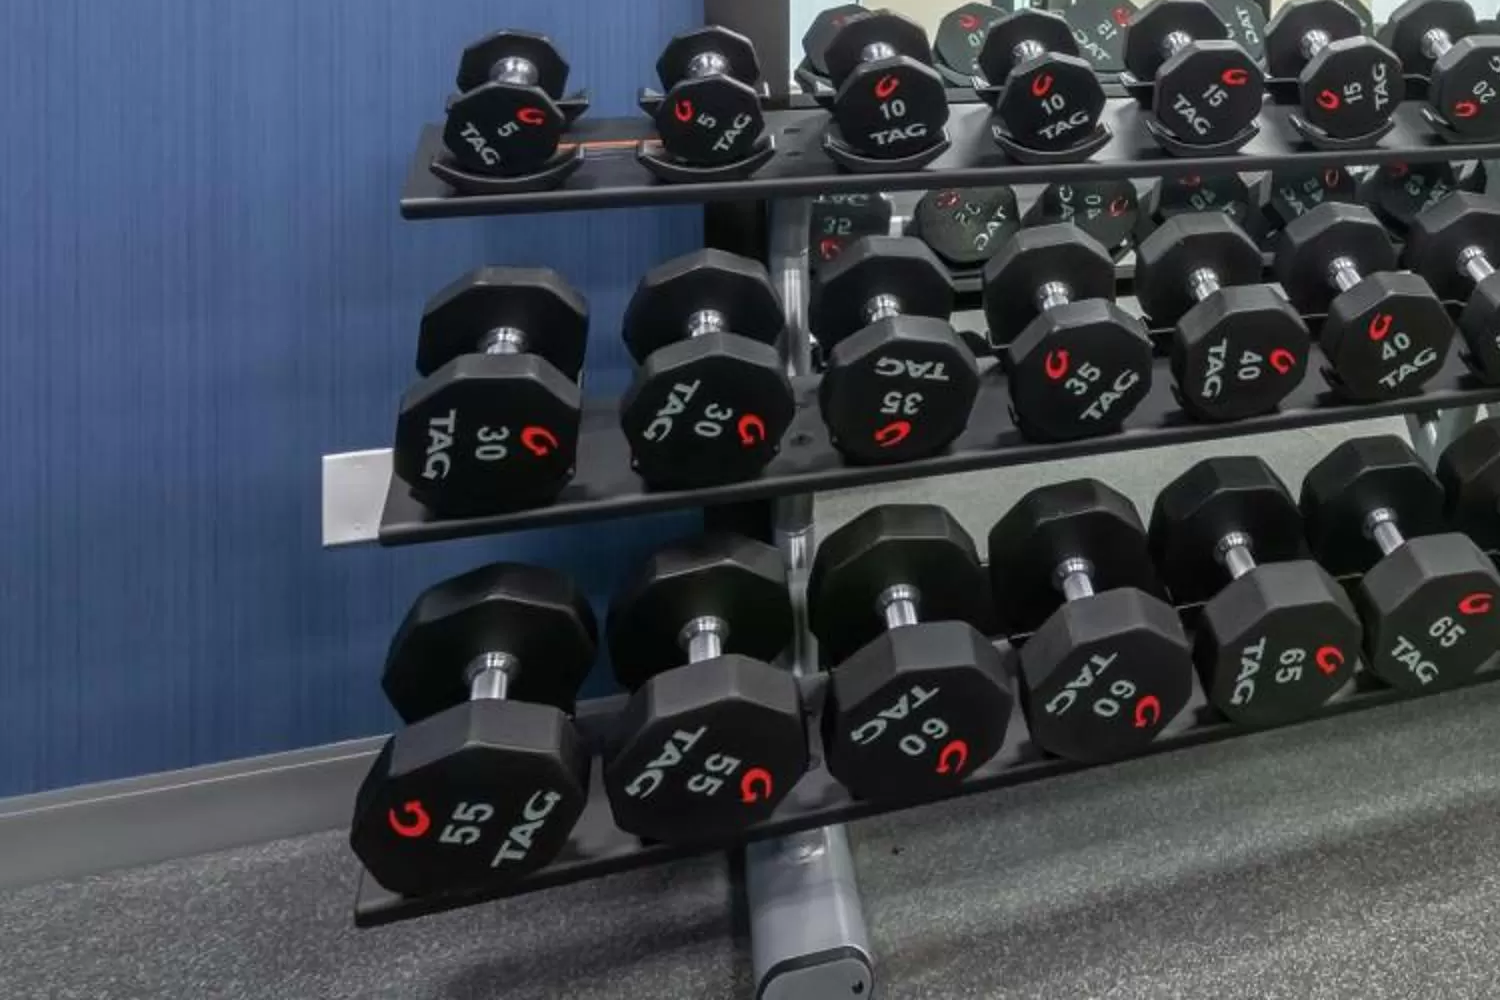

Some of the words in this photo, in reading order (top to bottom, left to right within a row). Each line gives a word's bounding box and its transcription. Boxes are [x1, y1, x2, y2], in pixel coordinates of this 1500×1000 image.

[1041, 94, 1065, 115] 10
[1203, 85, 1228, 106] 15
[1344, 82, 1362, 104] 15
[1372, 62, 1388, 111] TAG
[1472, 81, 1496, 103] 20
[697, 114, 716, 128] 5
[880, 100, 905, 119] 10
[1037, 111, 1090, 140] TAG
[1173, 93, 1212, 135] TAG
[460, 121, 501, 165] TAG
[498, 122, 519, 136] 5
[712, 113, 752, 152] TAG
[870, 124, 926, 144] TAG
[1383, 333, 1410, 360] 40
[876, 357, 948, 380] TAG
[1065, 362, 1100, 395] 35
[1202, 339, 1227, 397] TAG
[1238, 351, 1262, 379] 40
[1378, 347, 1437, 389] TAG
[644, 380, 701, 440] TAG
[880, 392, 922, 414] 35
[1080, 369, 1140, 421] TAG
[694, 404, 732, 437] 30
[422, 410, 456, 479] TAG
[476, 427, 509, 460] 30
[1429, 616, 1465, 647] 65
[1231, 638, 1266, 704] TAG
[1276, 648, 1305, 683] 65
[1392, 636, 1438, 684] TAG
[1046, 653, 1120, 716] TAG
[1094, 680, 1136, 716] 60
[850, 684, 940, 745] TAG
[899, 717, 949, 756] 60
[626, 726, 708, 797] TAG
[688, 754, 740, 795] 55
[440, 802, 493, 844] 55
[490, 789, 562, 869] TAG
